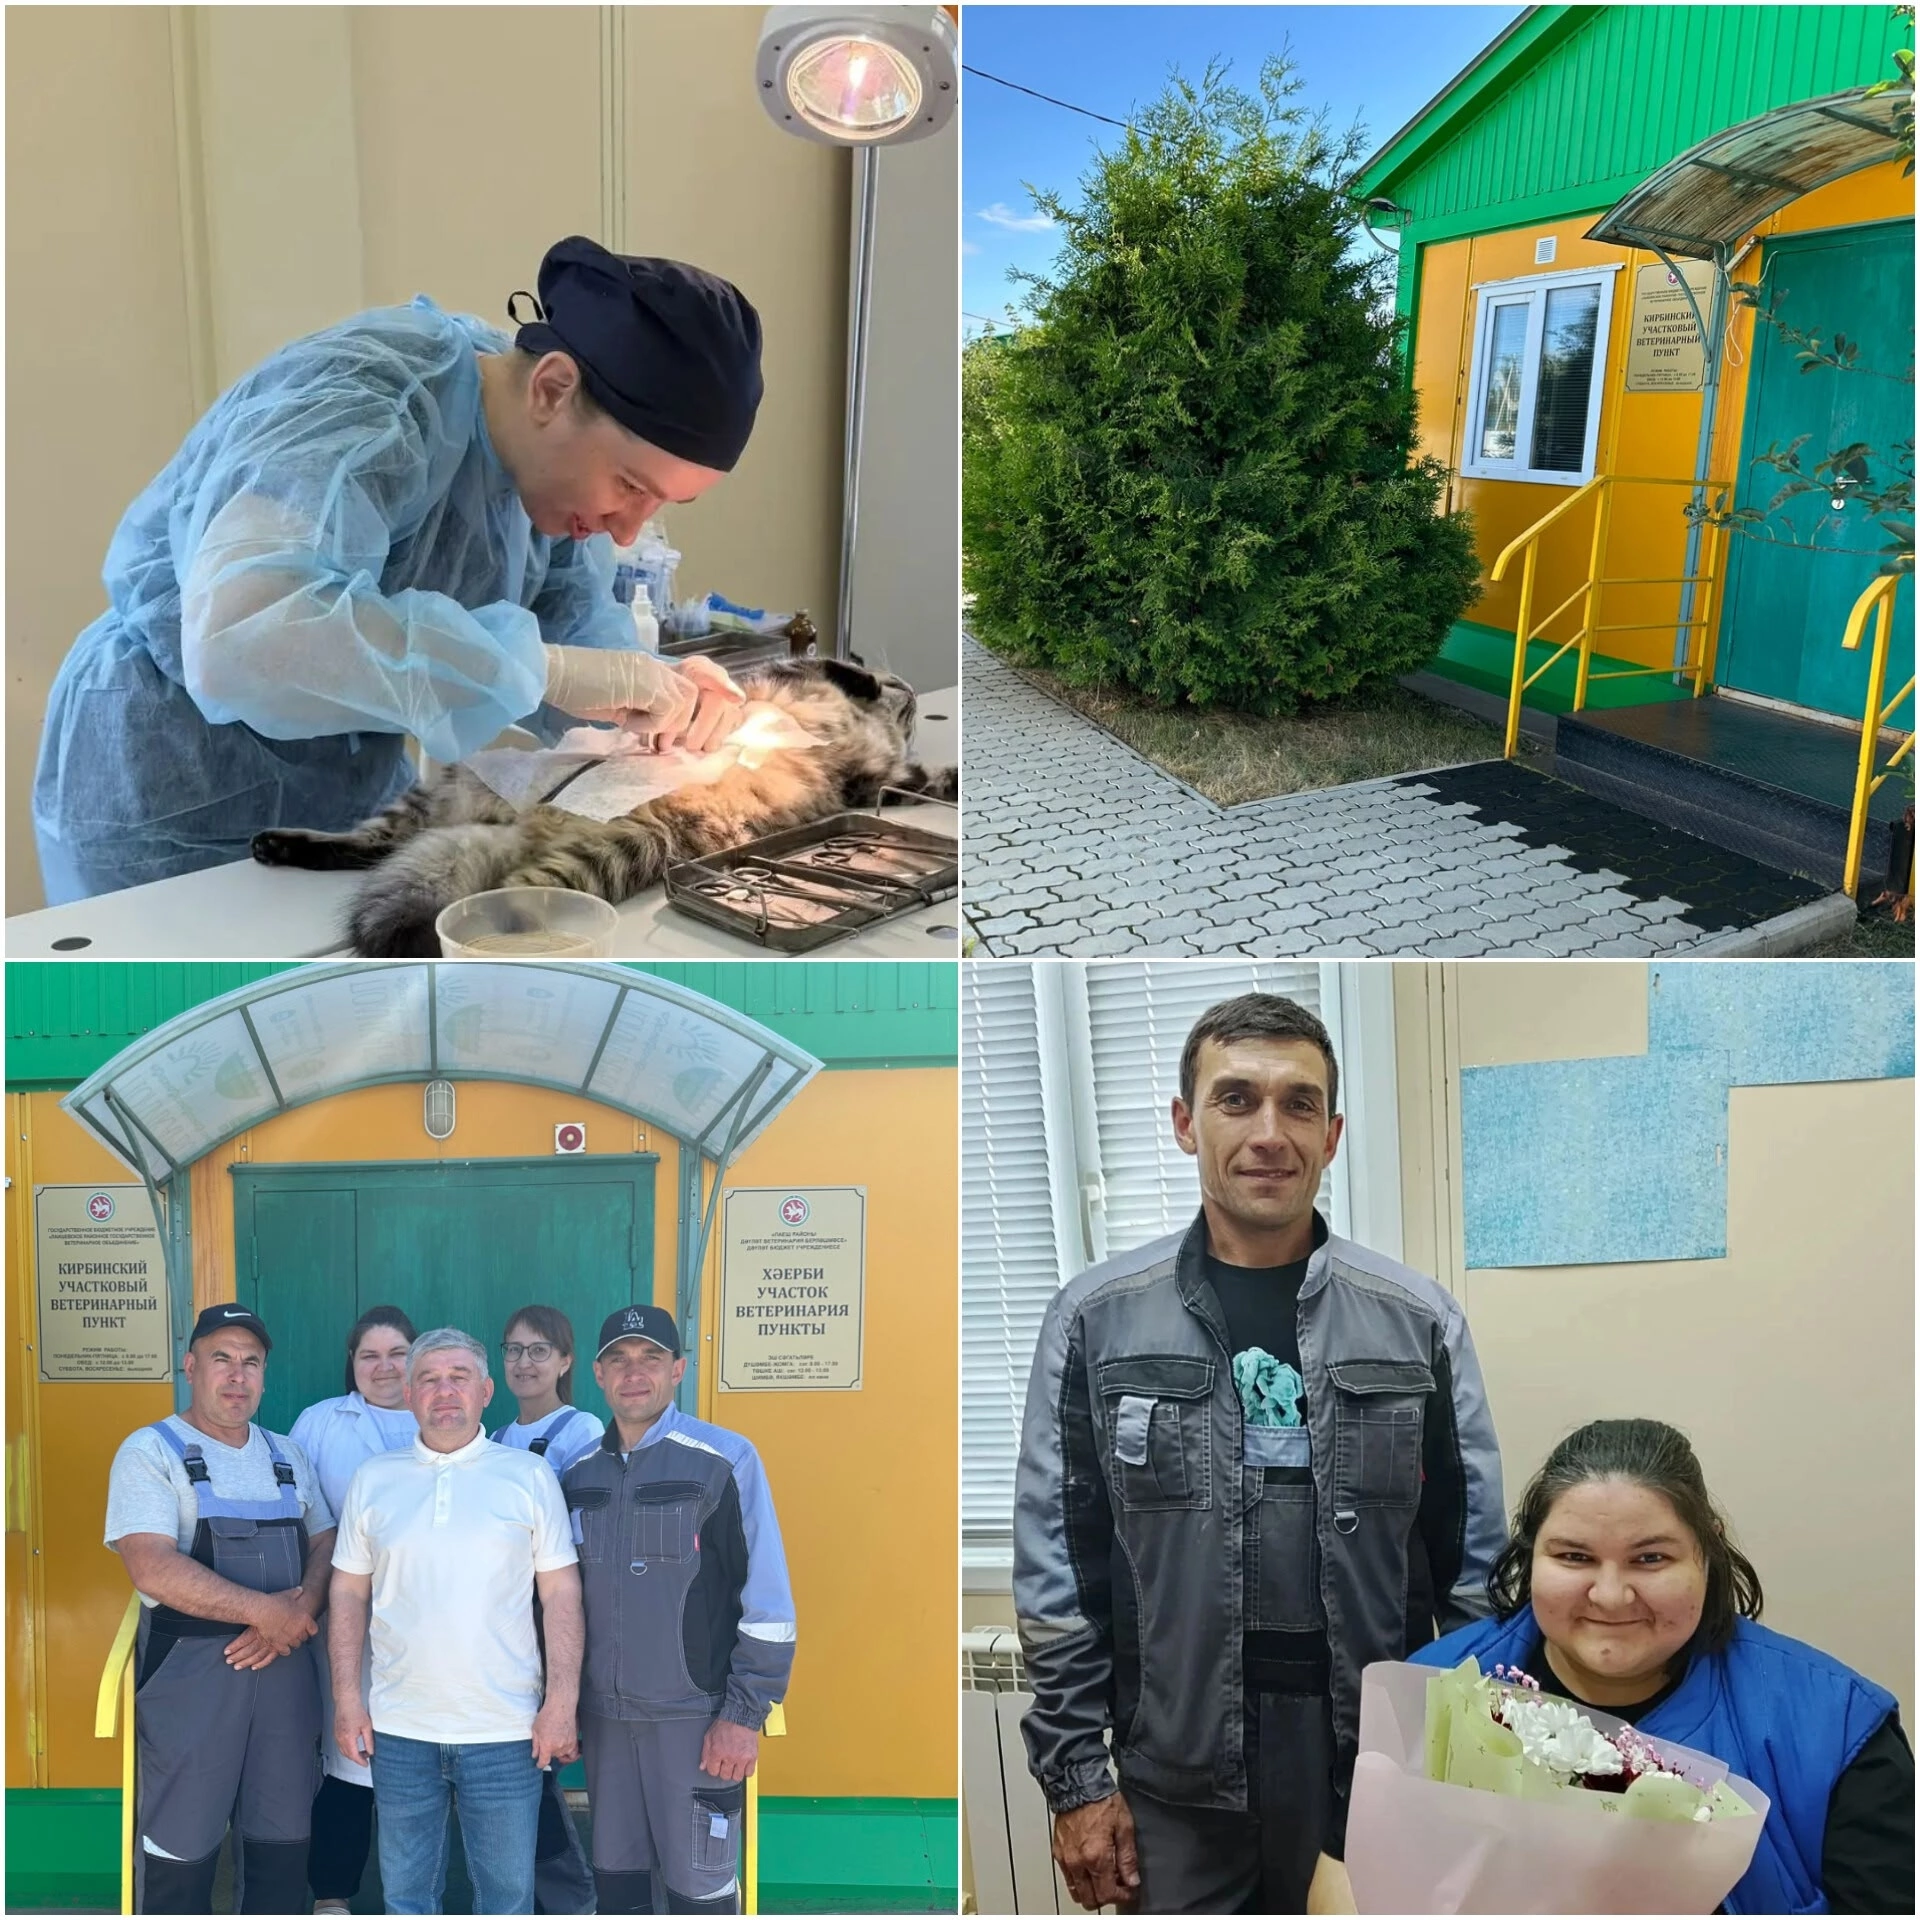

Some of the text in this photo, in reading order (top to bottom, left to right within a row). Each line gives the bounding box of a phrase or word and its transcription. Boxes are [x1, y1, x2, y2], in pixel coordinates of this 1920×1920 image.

[1643, 321, 1697, 334] УЧАСТКОВЫЙ
[1653, 348, 1680, 357] ПУНКТ
[58, 1260, 148, 1275] КИРБИНСКИЙ
[762, 1267, 824, 1280] ХӘЕРБИ
[58, 1278, 148, 1293] УЧАСТКОВЫЙ
[757, 1286, 829, 1299] УЧАСТОК
[50, 1295, 157, 1311] ВЕТЕРИНАРНЫЙ
[735, 1304, 849, 1318] ВЕТЕРИНАРИЯ
[82, 1316, 127, 1329] ПУНКТ
[758, 1323, 826, 1336] ПУНКТЫ
